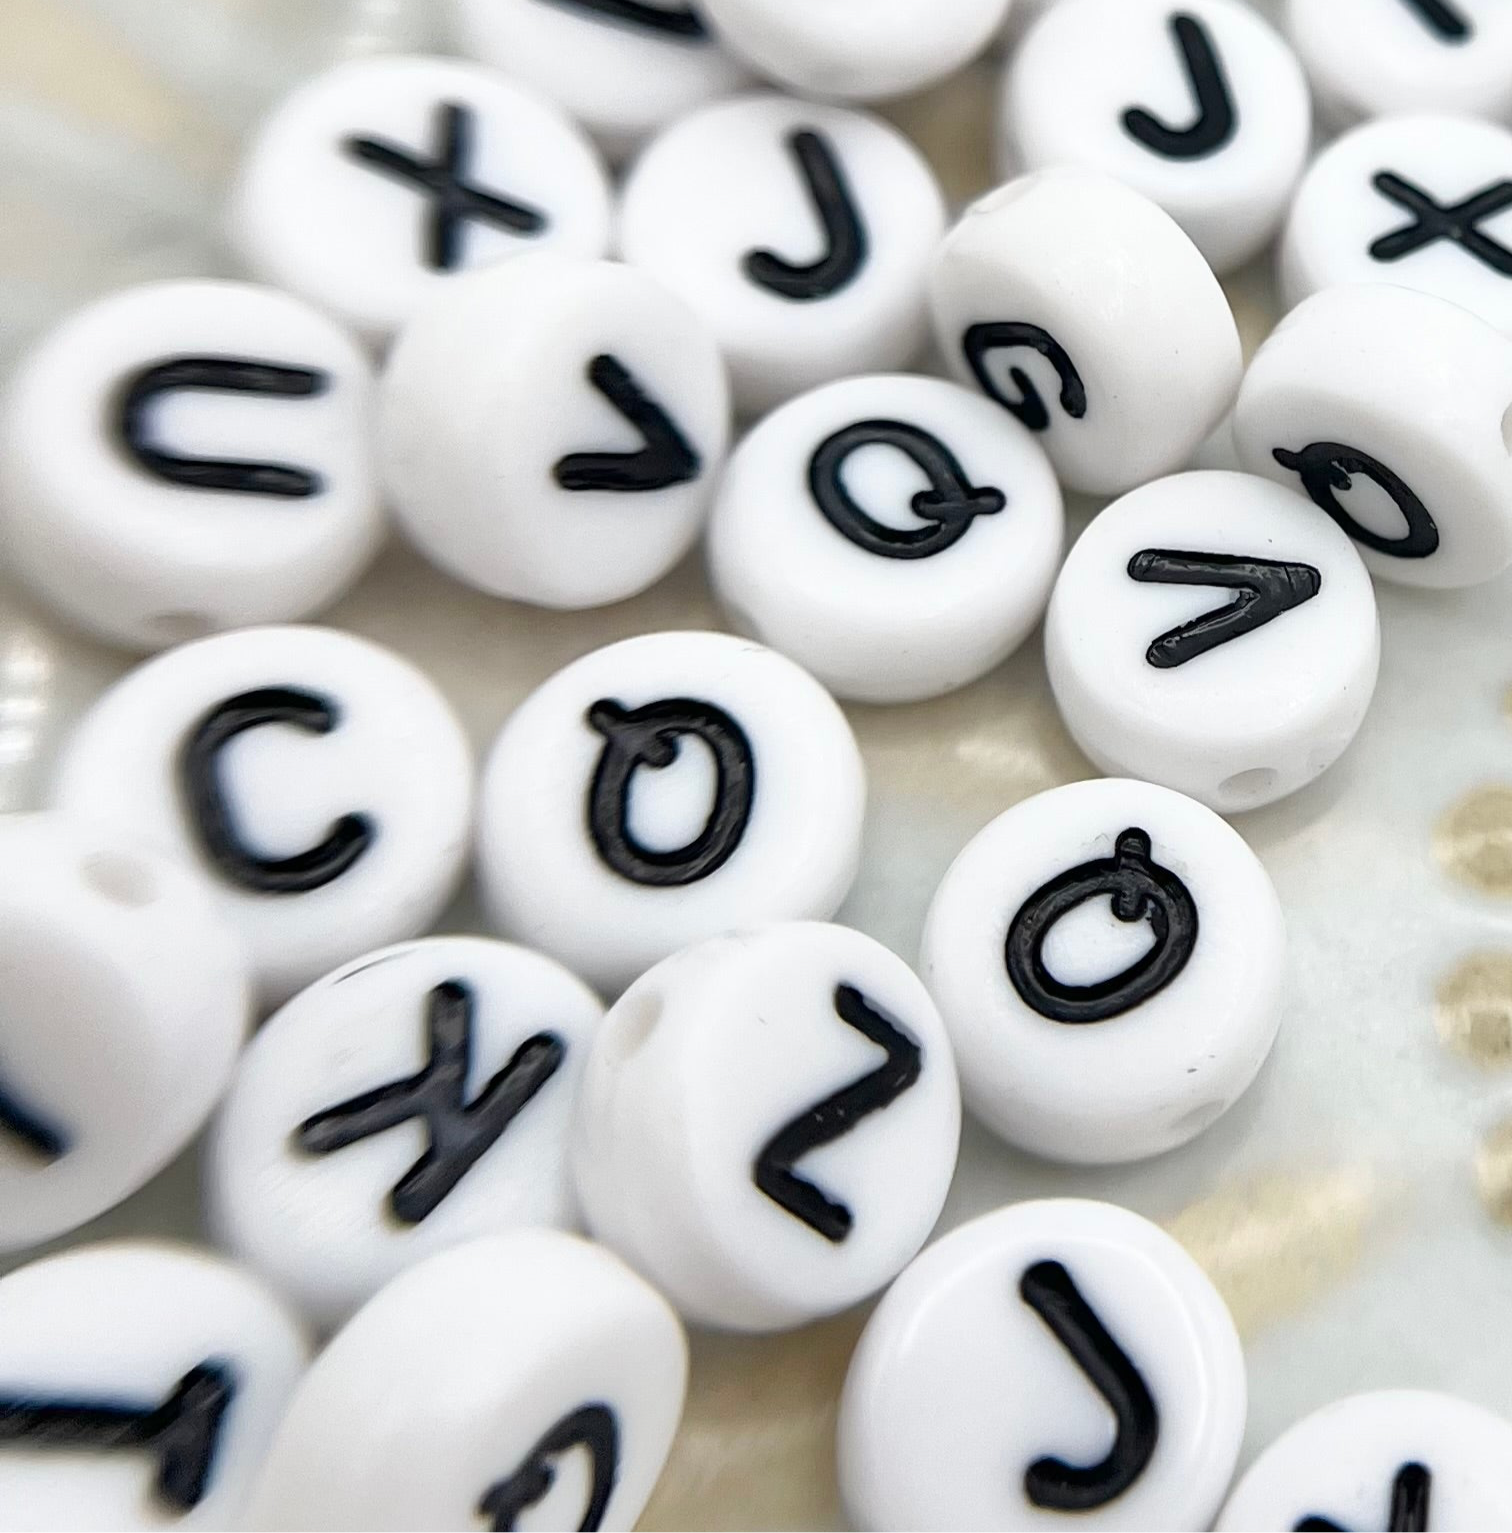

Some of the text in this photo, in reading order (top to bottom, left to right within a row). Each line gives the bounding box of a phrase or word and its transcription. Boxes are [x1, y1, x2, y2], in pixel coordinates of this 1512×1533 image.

[1118, 11, 1239, 163] J
[342, 103, 547, 274] X
[741, 123, 870, 304] J
[106, 353, 330, 501] U
[552, 352, 705, 494] V
[962, 320, 1088, 432] G
[805, 417, 1008, 561] Q
[1271, 440, 1441, 561] Q
[1126, 547, 1322, 670] V
[173, 684, 379, 900] C
[582, 696, 758, 891] Q
[1003, 826, 1200, 1026] Q
[290, 978, 569, 1230] K
[750, 980, 924, 1247] Z
[1016, 1258, 1163, 1518] J
